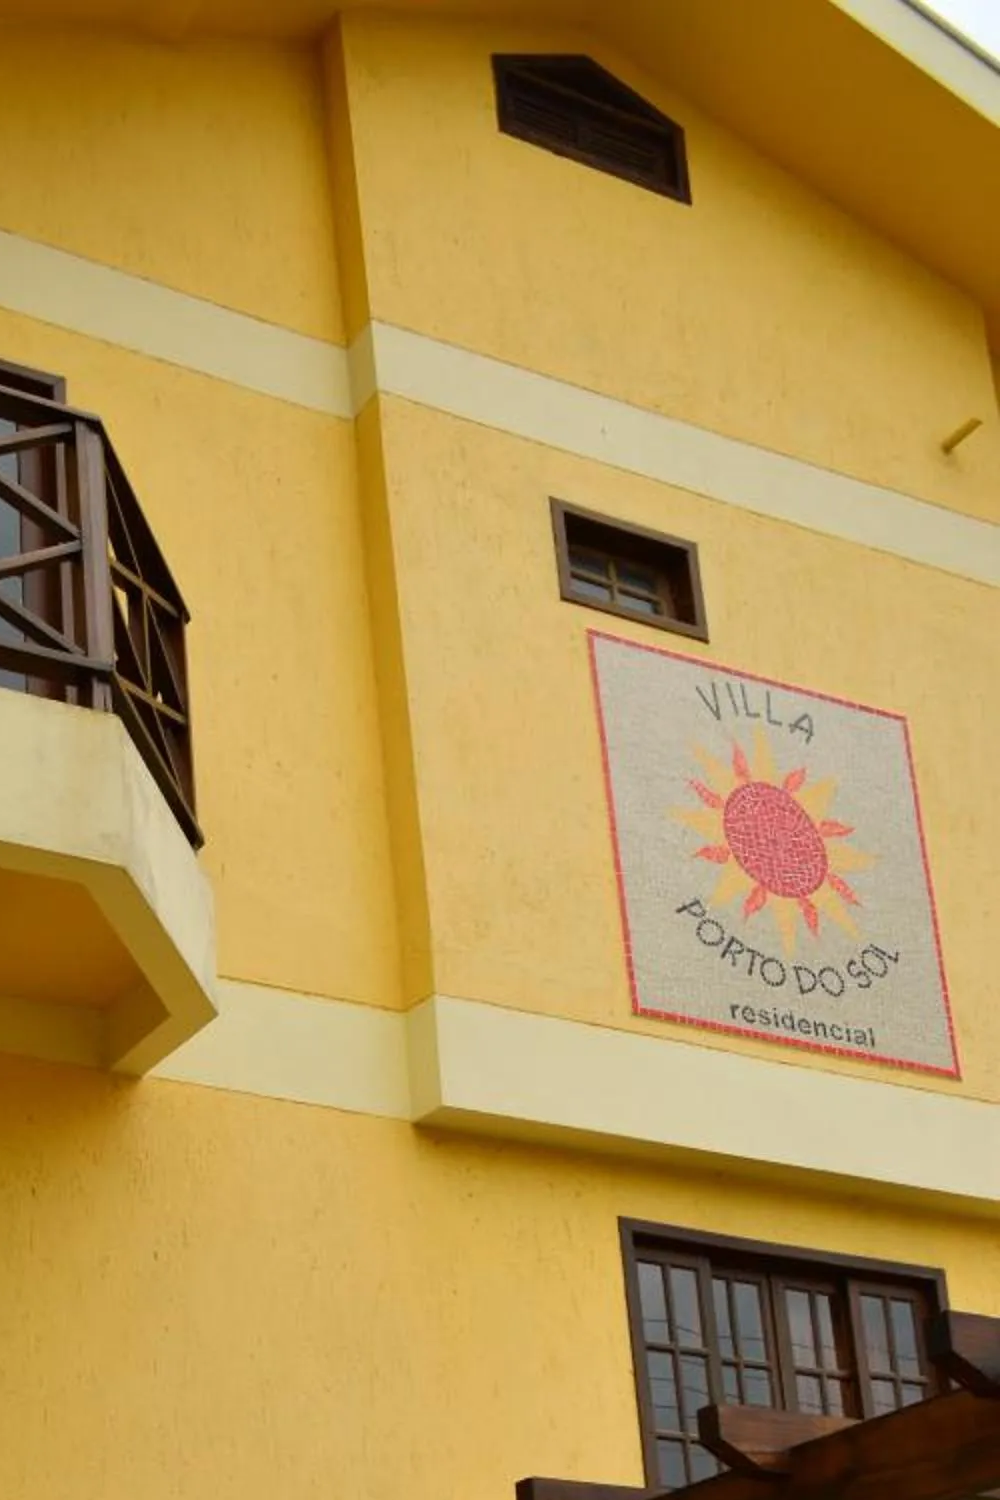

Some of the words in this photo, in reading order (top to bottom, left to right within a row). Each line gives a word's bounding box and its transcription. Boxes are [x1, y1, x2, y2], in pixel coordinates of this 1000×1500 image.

[696, 682, 815, 744] VILLA
[676, 897, 786, 987] PORTO
[794, 964, 845, 997] DO
[847, 943, 900, 989] SOL
[729, 1001, 876, 1047] residencial
